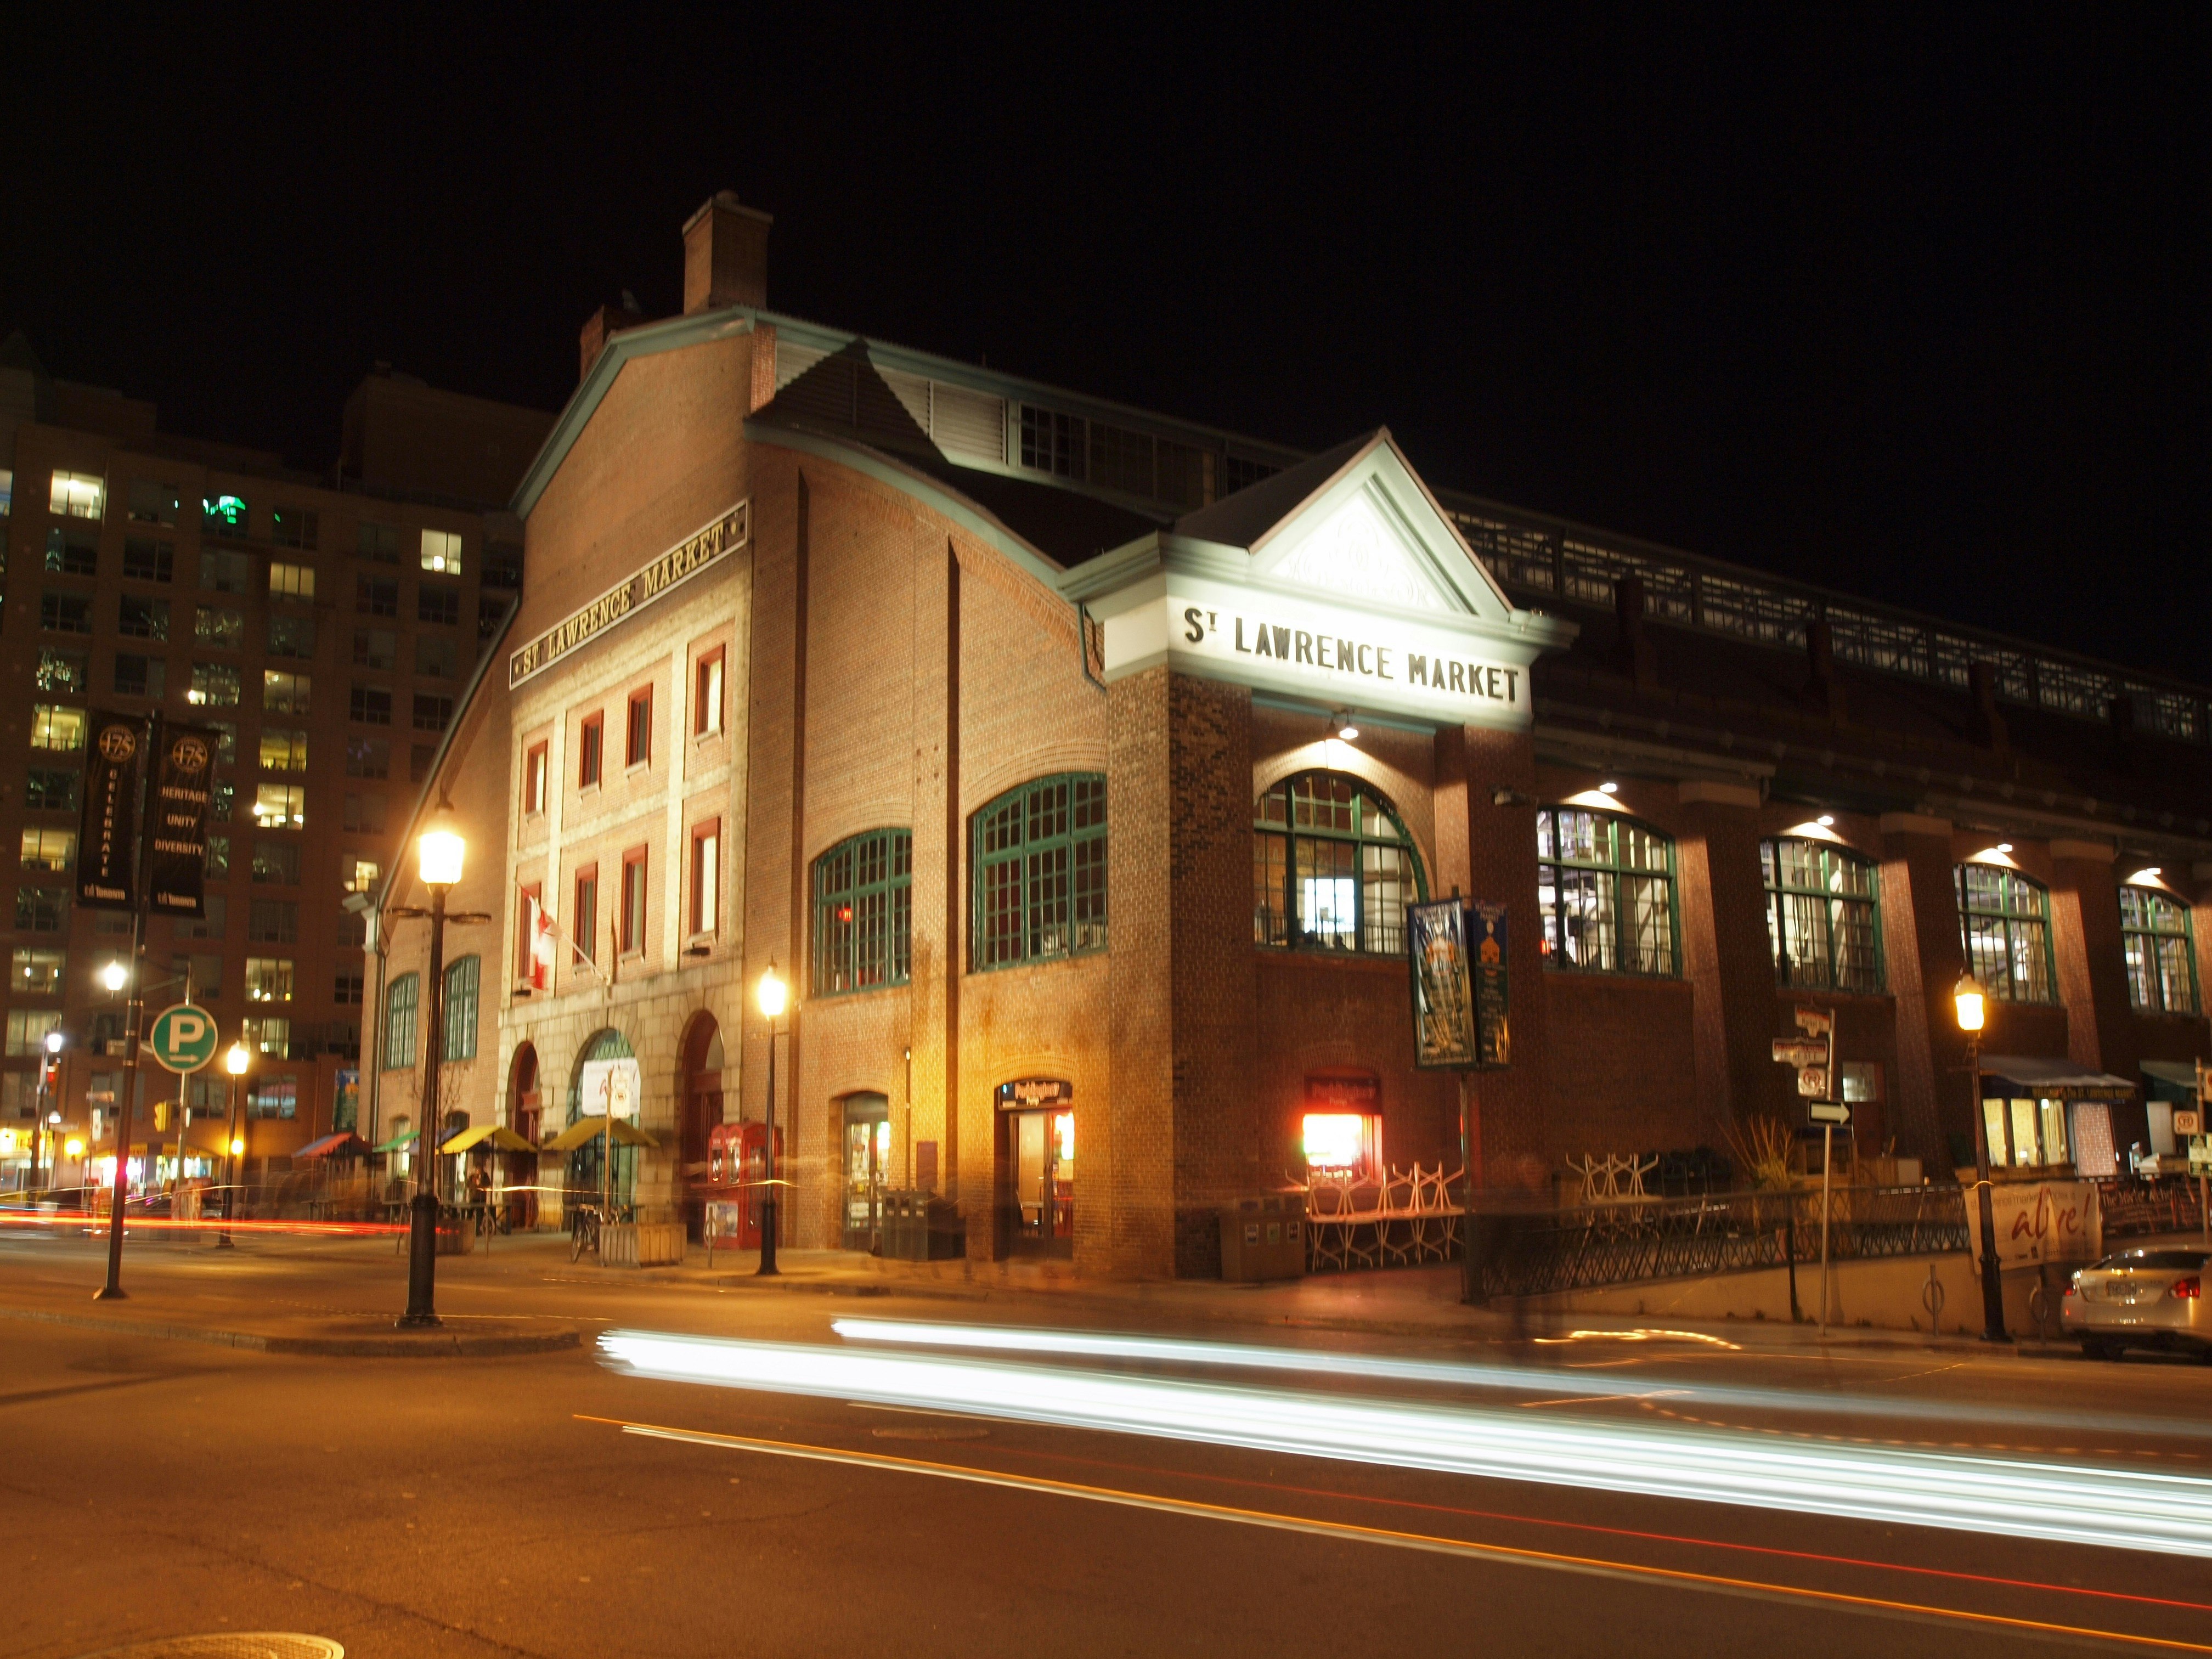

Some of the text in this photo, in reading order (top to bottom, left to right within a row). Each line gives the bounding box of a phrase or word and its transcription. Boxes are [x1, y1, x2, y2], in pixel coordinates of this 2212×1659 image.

[548, 582, 630, 660] LAWRENCE
[641, 521, 724, 600] MARKET
[1235, 617, 1393, 679] LAWRENCE
[1408, 653, 1518, 702] MARKET
[162, 786, 207, 803] HERITAGE
[167, 814, 196, 828] UNITY
[155, 838, 204, 856] DIVERSITY
[169, 1014, 205, 1053] P
